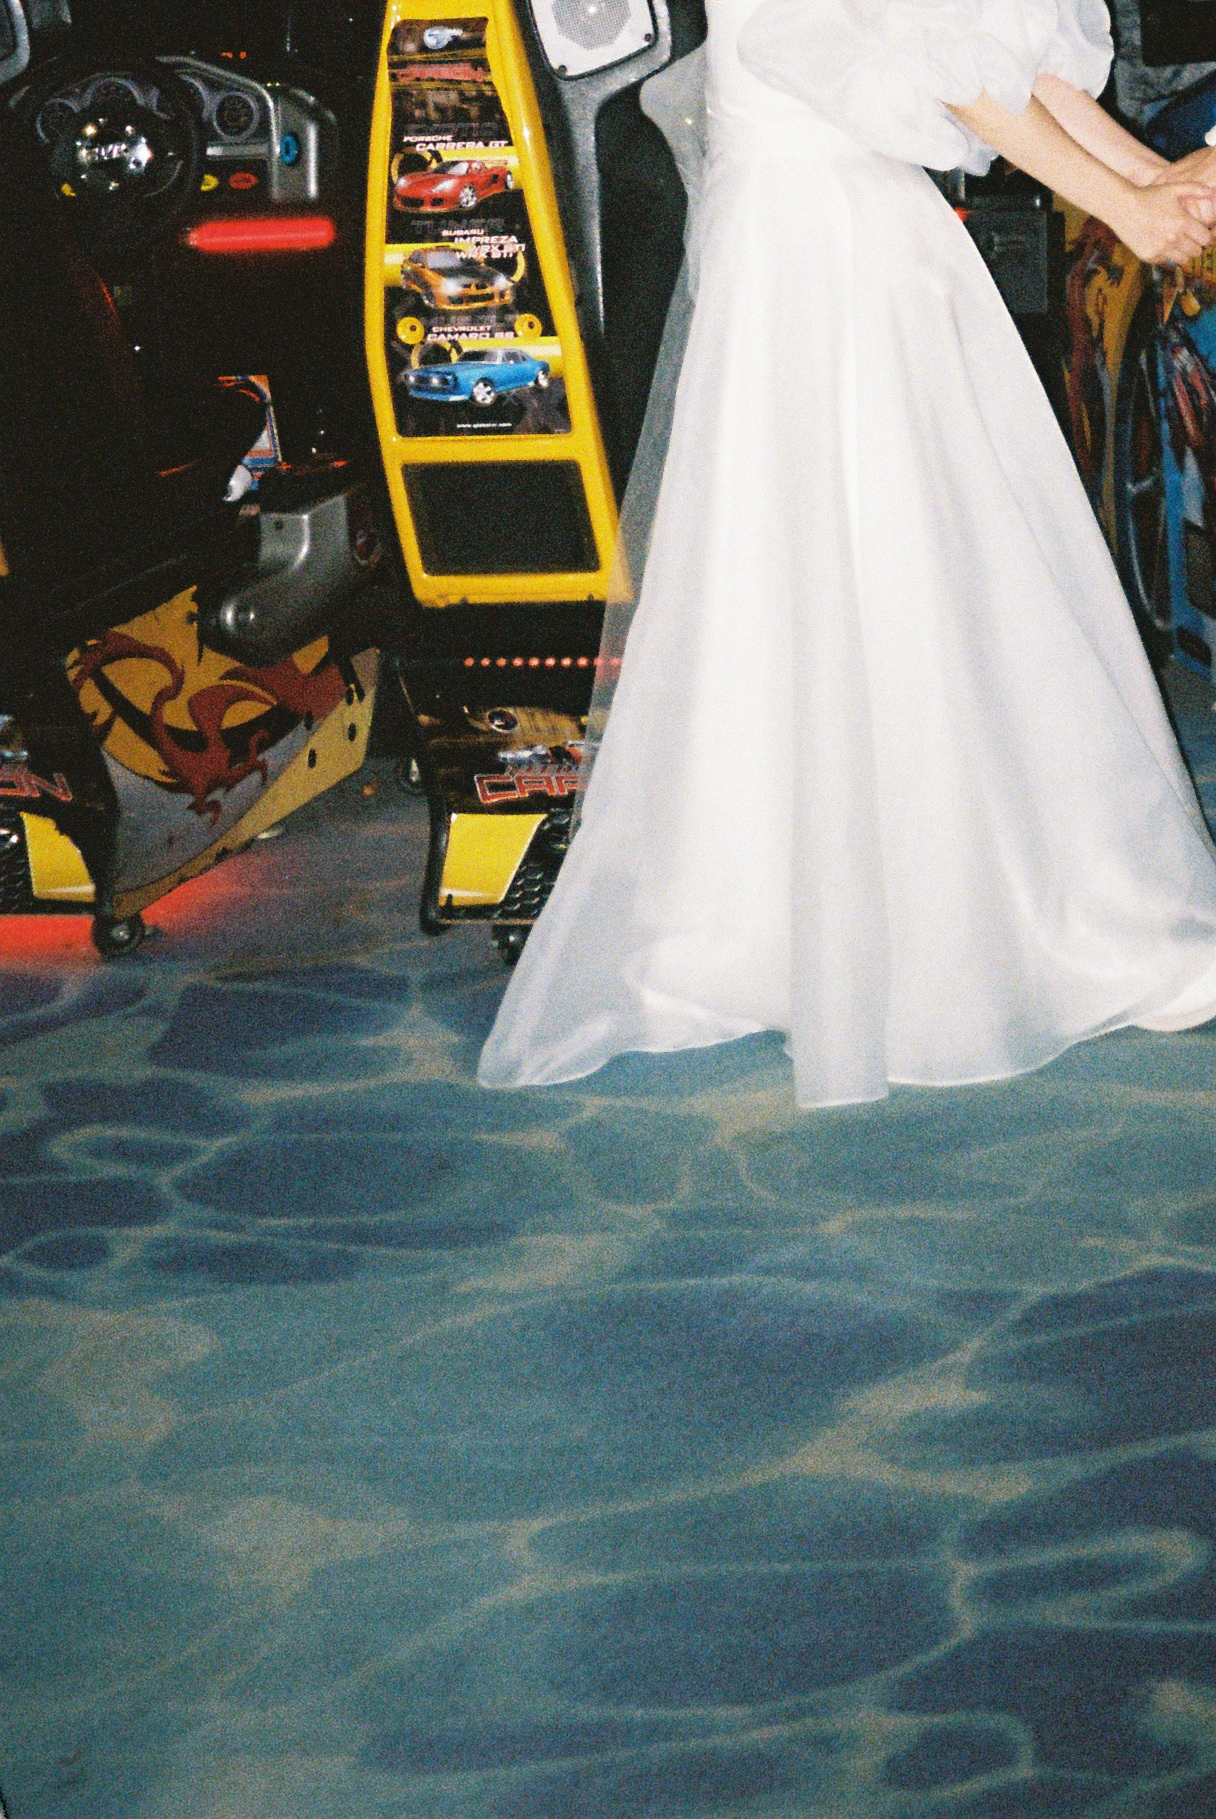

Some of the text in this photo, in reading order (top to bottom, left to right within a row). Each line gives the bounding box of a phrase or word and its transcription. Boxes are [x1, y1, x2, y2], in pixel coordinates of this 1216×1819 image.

[416, 141, 485, 152] CARRERA
[441, 228, 484, 236] SUBARU
[453, 235, 519, 244] IMPREZA
[432, 325, 491, 333] CHEVROLET
[426, 332, 491, 341] CAMARO
